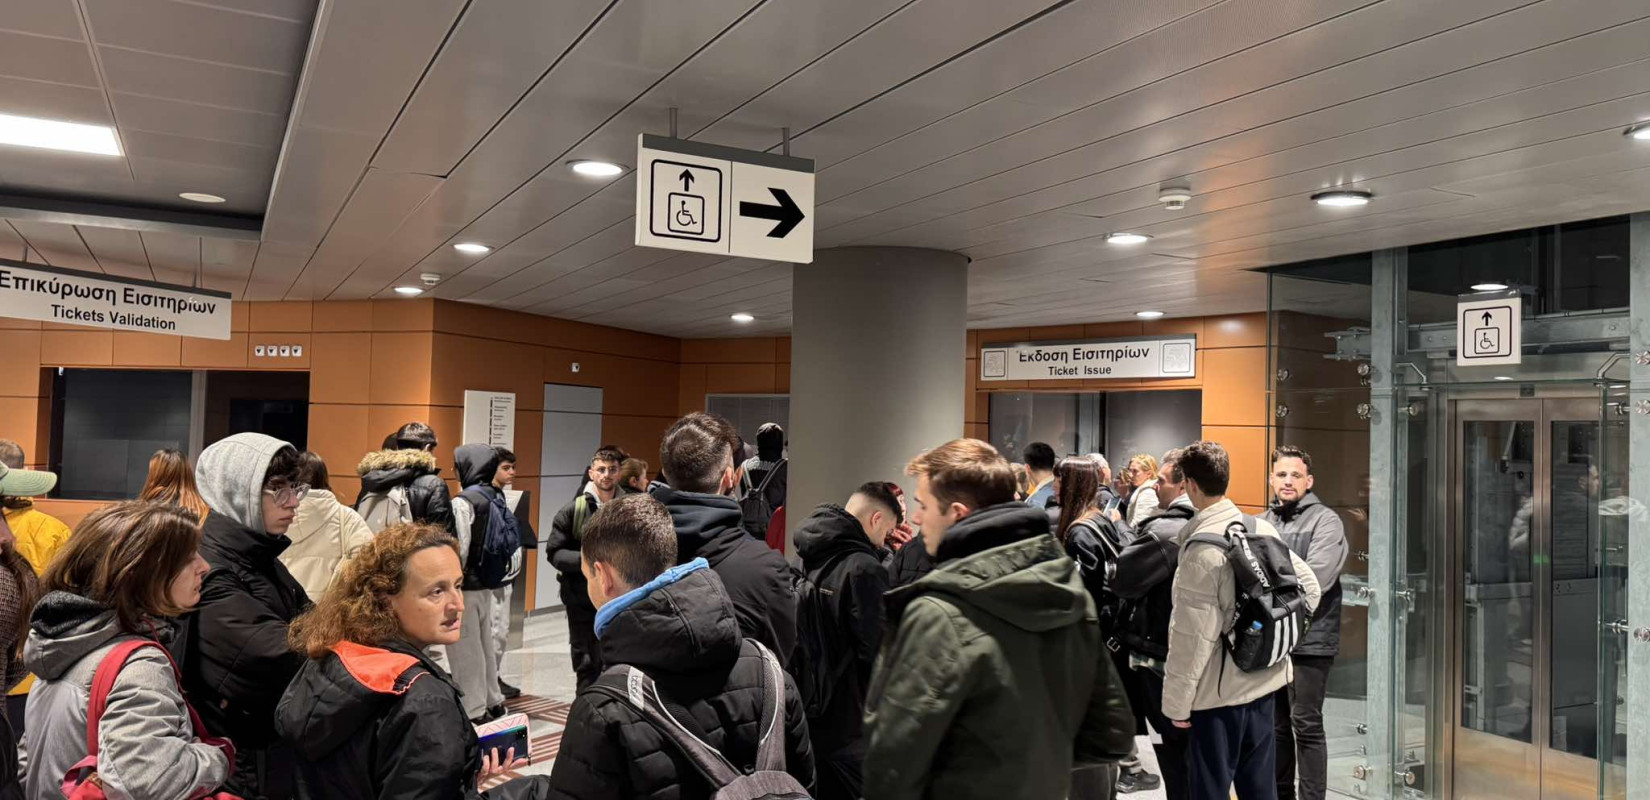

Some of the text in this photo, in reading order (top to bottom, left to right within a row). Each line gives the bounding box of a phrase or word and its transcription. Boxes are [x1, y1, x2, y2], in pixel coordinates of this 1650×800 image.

[0, 271, 117, 306] Επικύρωση
[51, 304, 176, 331] Tickets Validation
[1073, 346, 1150, 362] Εισιτηρίων
[1048, 365, 1112, 376] Ticket Issue
[1251, 561, 1271, 588] ADIDAS
